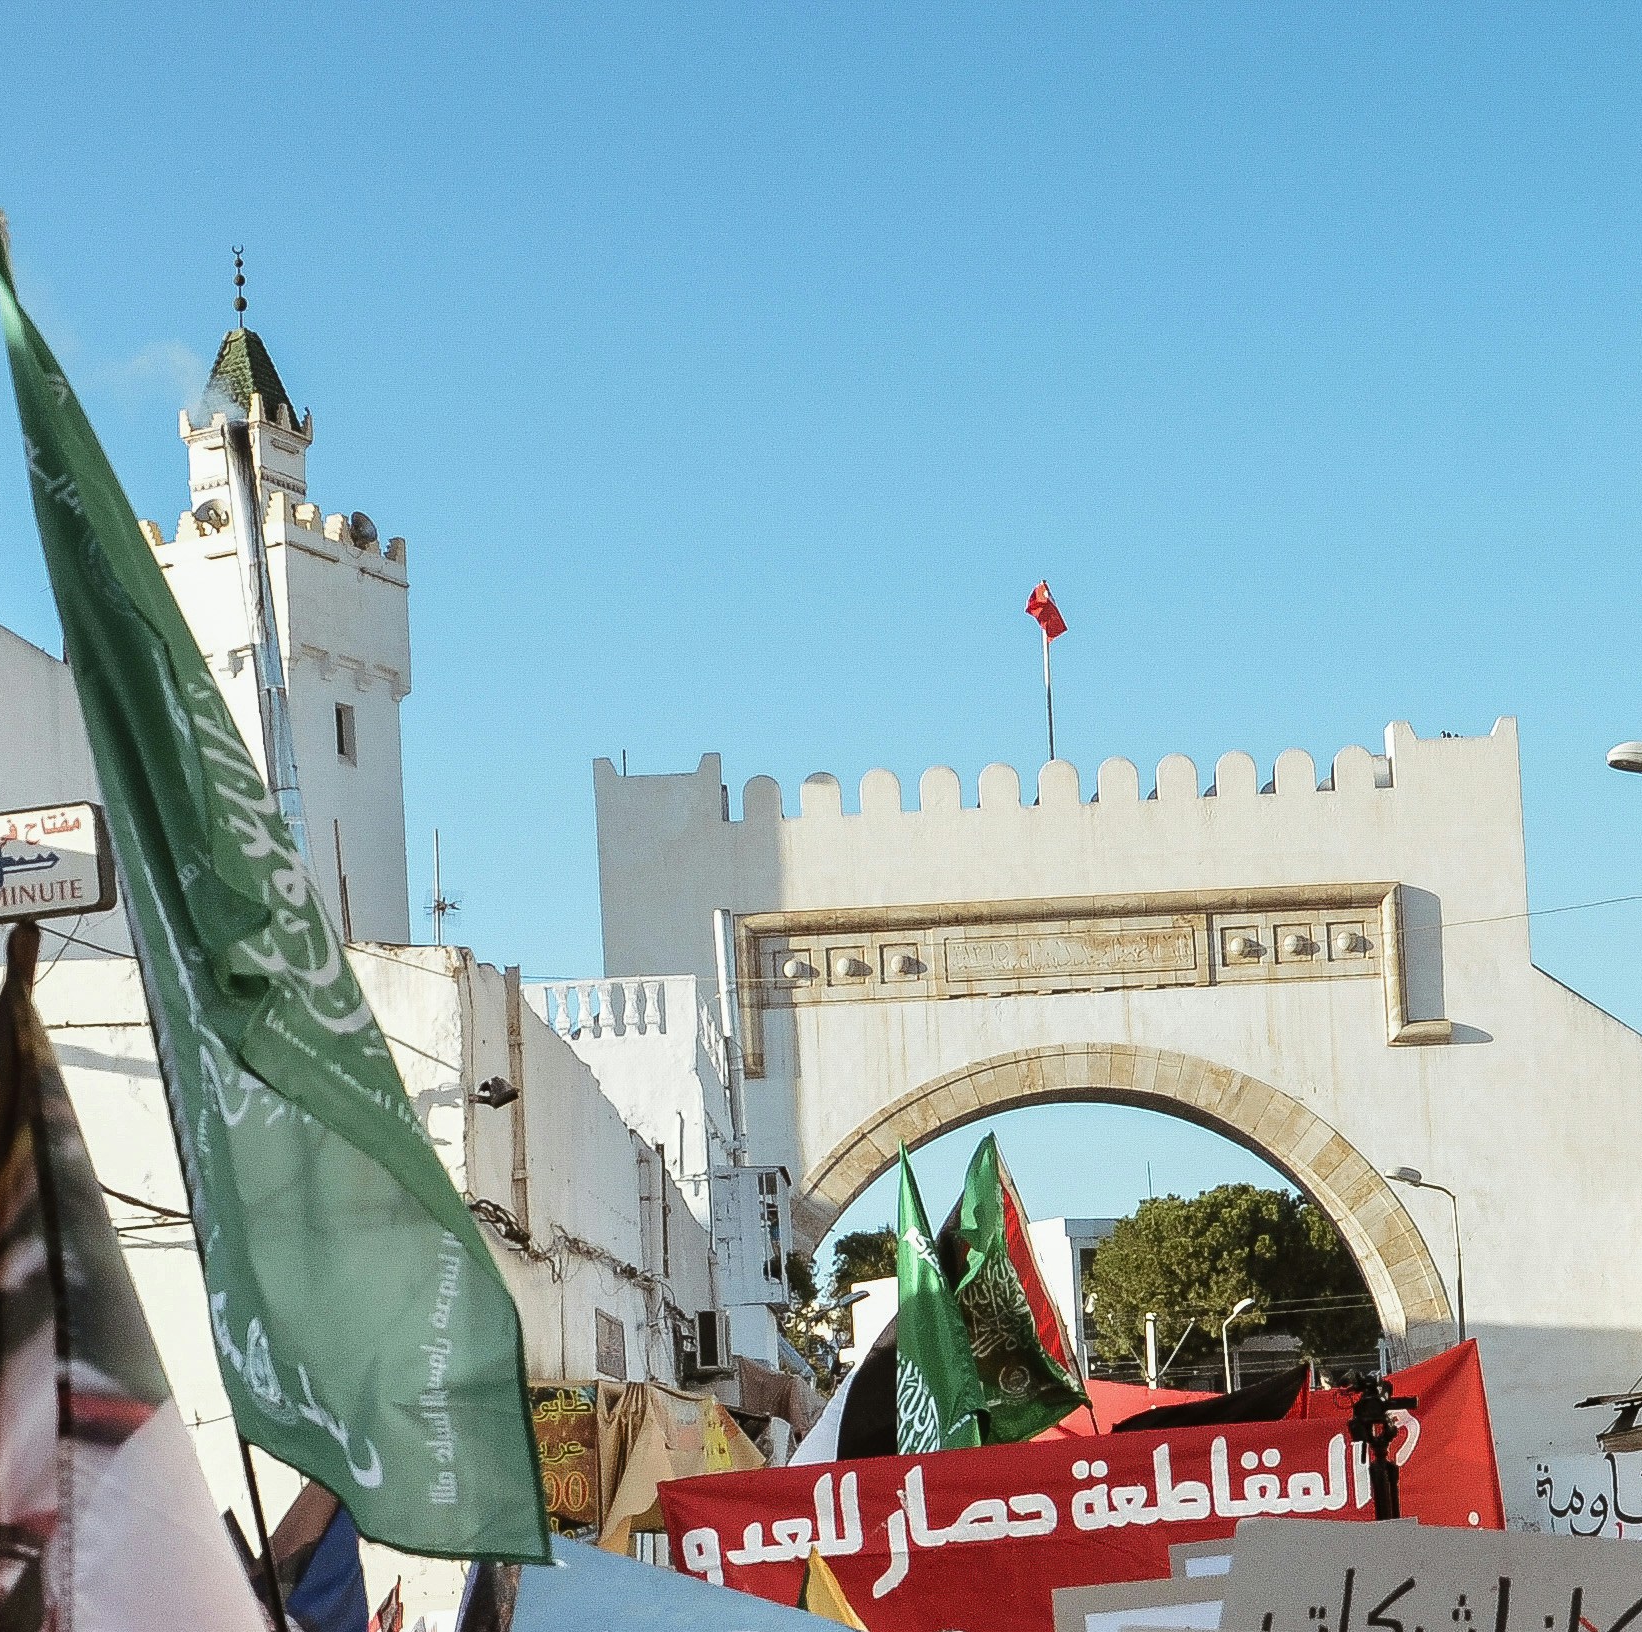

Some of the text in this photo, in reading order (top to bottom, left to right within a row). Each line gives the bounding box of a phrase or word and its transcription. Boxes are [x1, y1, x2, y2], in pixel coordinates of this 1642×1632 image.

[23, 812, 81, 846] مفتاح
[681, 1471, 863, 1587] للعدو
[873, 1466, 1057, 1599] حصار
[1071, 1434, 1374, 1531] المقاطعة
